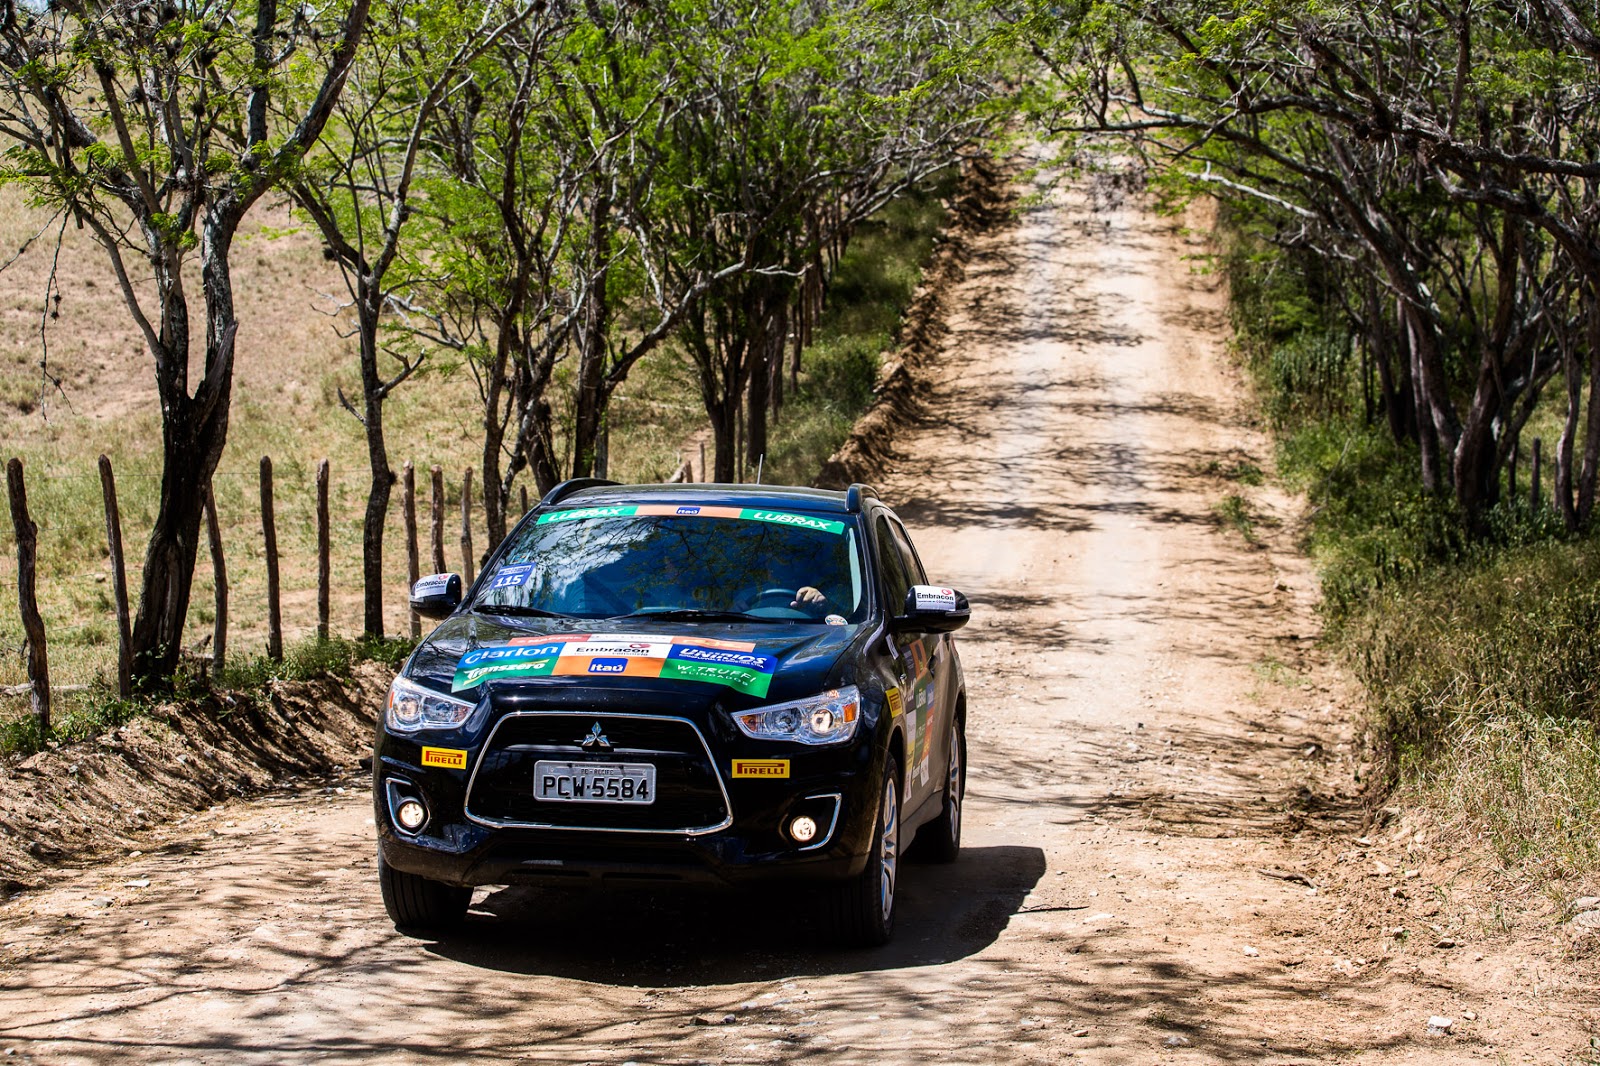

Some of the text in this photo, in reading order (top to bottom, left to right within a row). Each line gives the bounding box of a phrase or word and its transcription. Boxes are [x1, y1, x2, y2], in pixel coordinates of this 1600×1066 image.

[547, 508, 625, 521] LUBRAX
[753, 512, 832, 530] LUBRAX
[494, 574, 522, 588] 115
[916, 592, 954, 602] Embracon
[464, 646, 559, 665] Clarion
[463, 663, 546, 680] Transzero
[590, 663, 624, 672] Itaú
[680, 671, 749, 686] BLINDADOS
[425, 750, 463, 765] PIRELLI
[736, 762, 785, 775] PIRELLI
